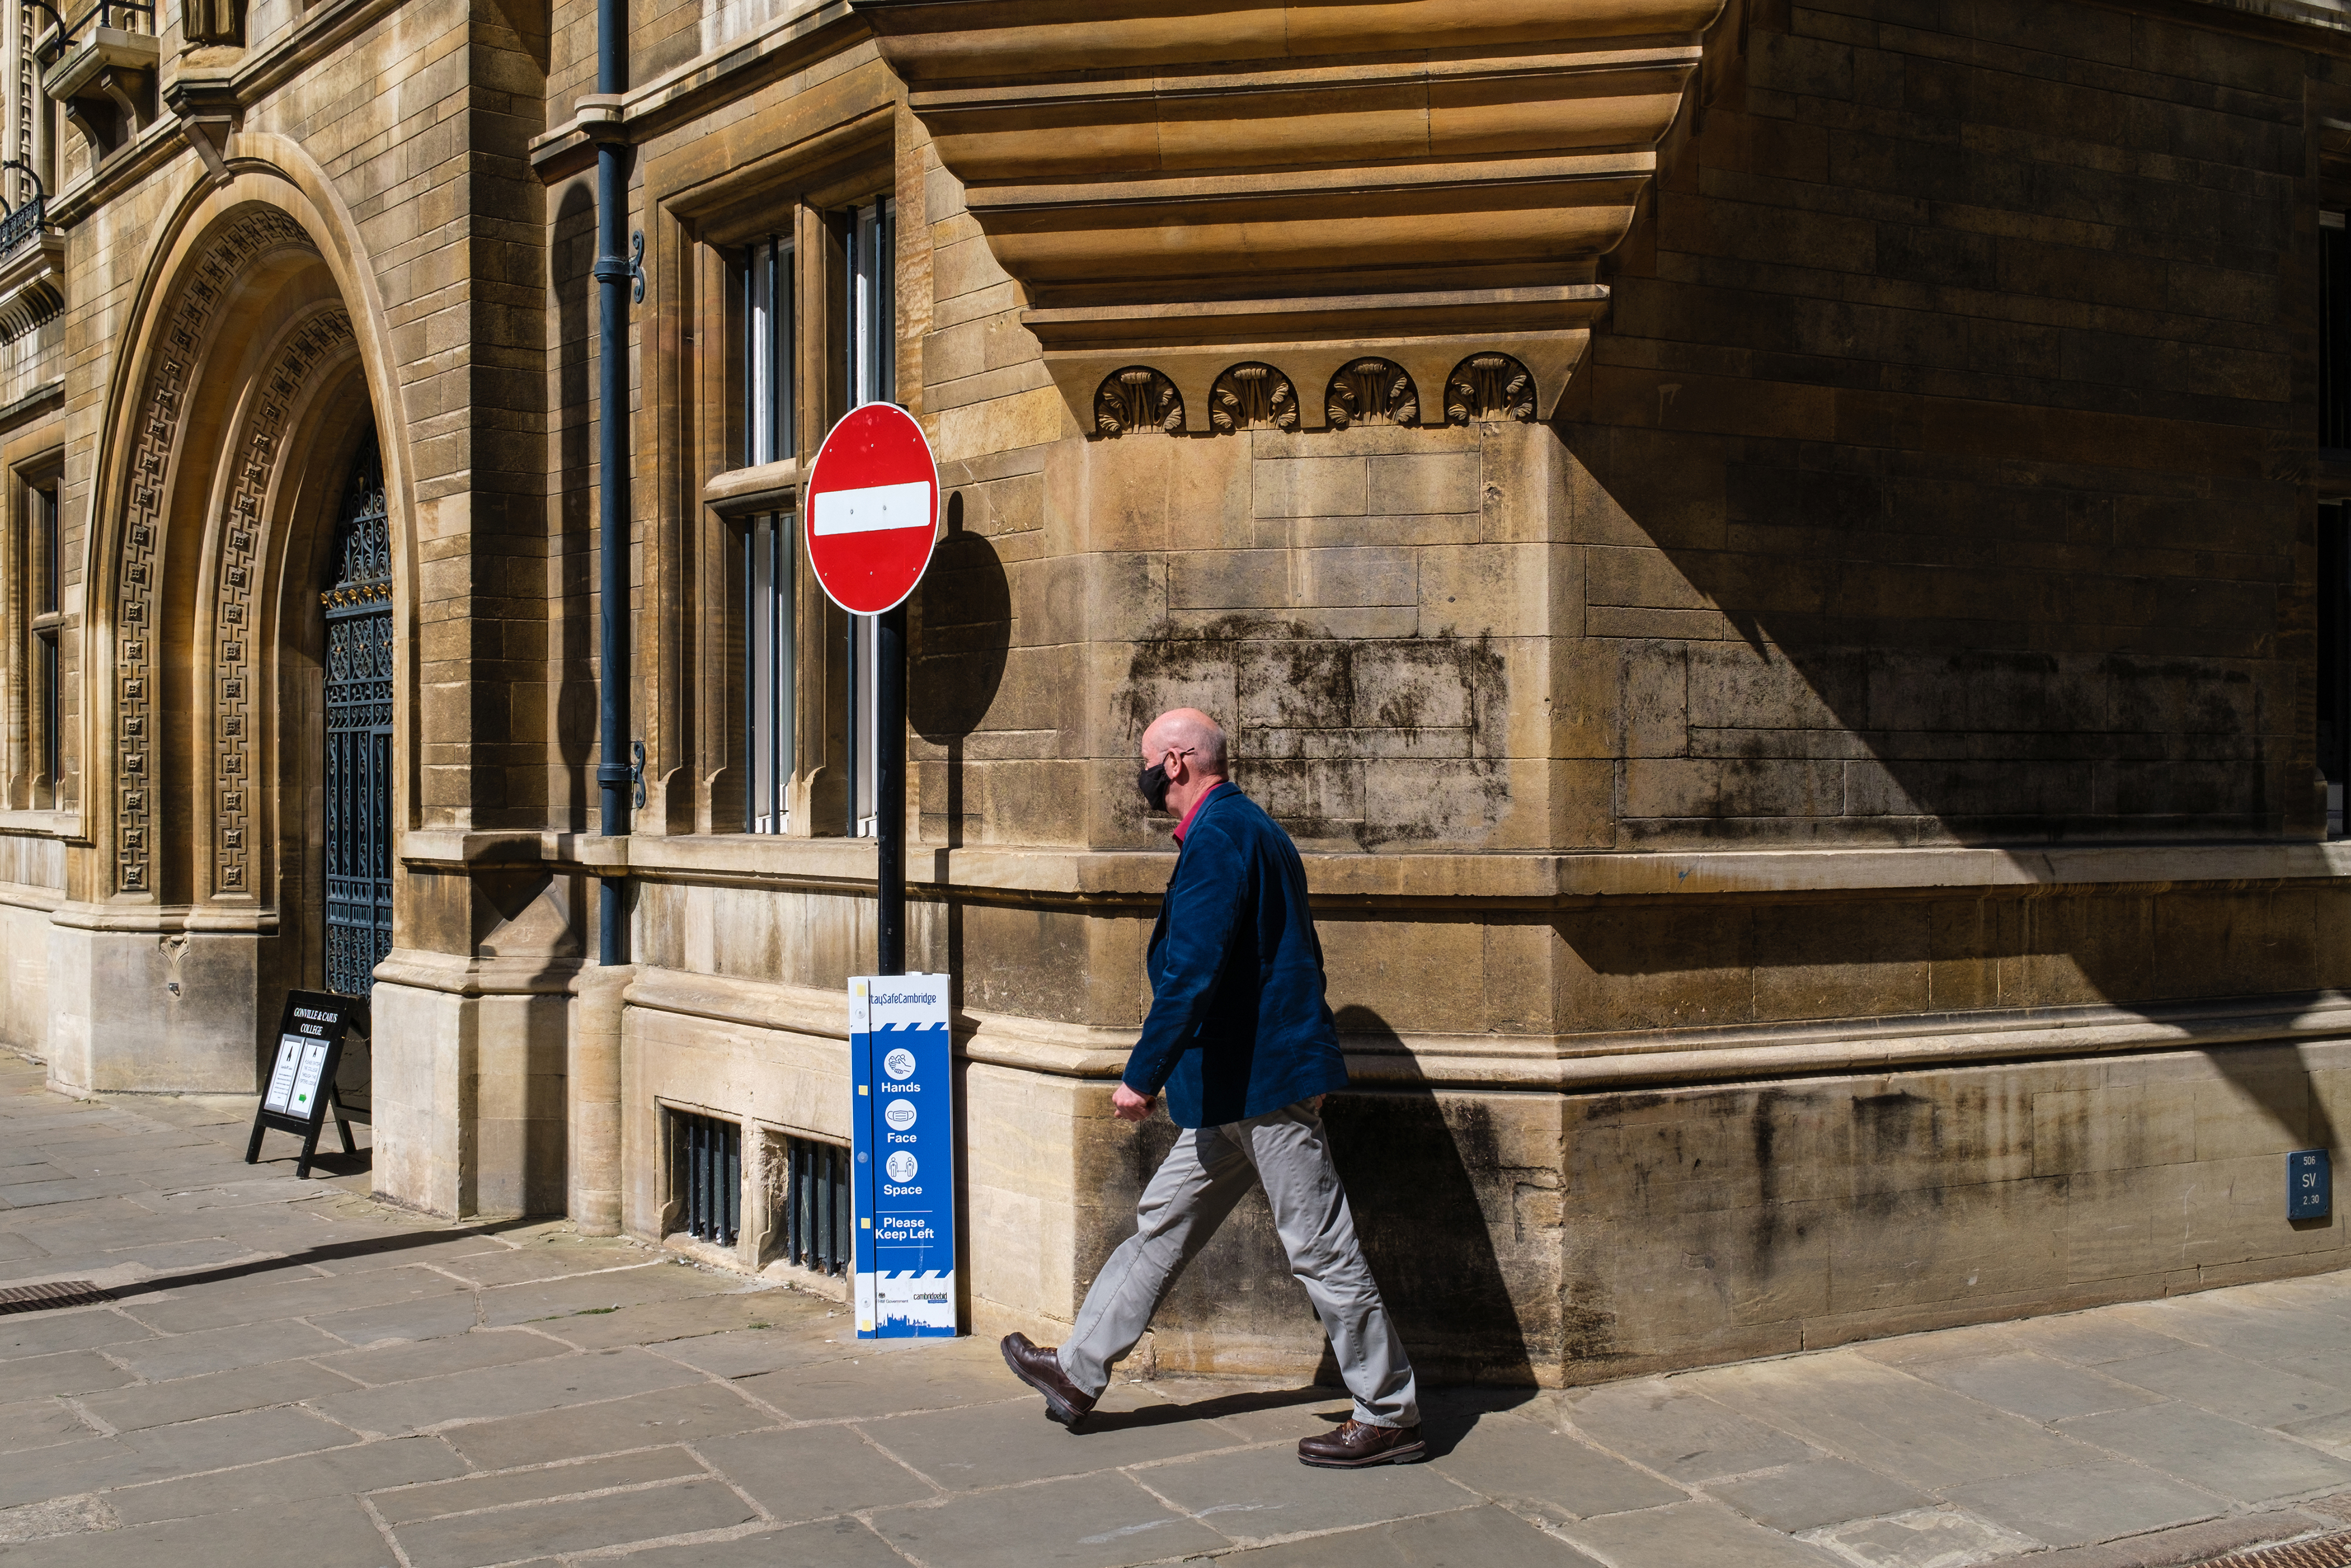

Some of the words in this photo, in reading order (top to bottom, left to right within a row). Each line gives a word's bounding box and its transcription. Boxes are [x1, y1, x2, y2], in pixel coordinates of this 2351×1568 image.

[869, 993, 936, 1006] taySafeCambridge
[294, 1007, 318, 1020] GONVILLE
[317, 1011, 322, 1020] &
[322, 1012, 338, 1023] CAIUS
[301, 1024, 323, 1035] COLLEGE
[881, 1082, 921, 1093] Hands
[887, 1133, 917, 1143] Face
[2303, 1156, 2315, 1166] 506
[2302, 1172, 2316, 1188] SV
[883, 1184, 923, 1197] Space
[2303, 1194, 2319, 1205] 2.30
[883, 1217, 925, 1228] Please
[875, 1229, 907, 1241] Keep
[910, 1228, 934, 1239] Left
